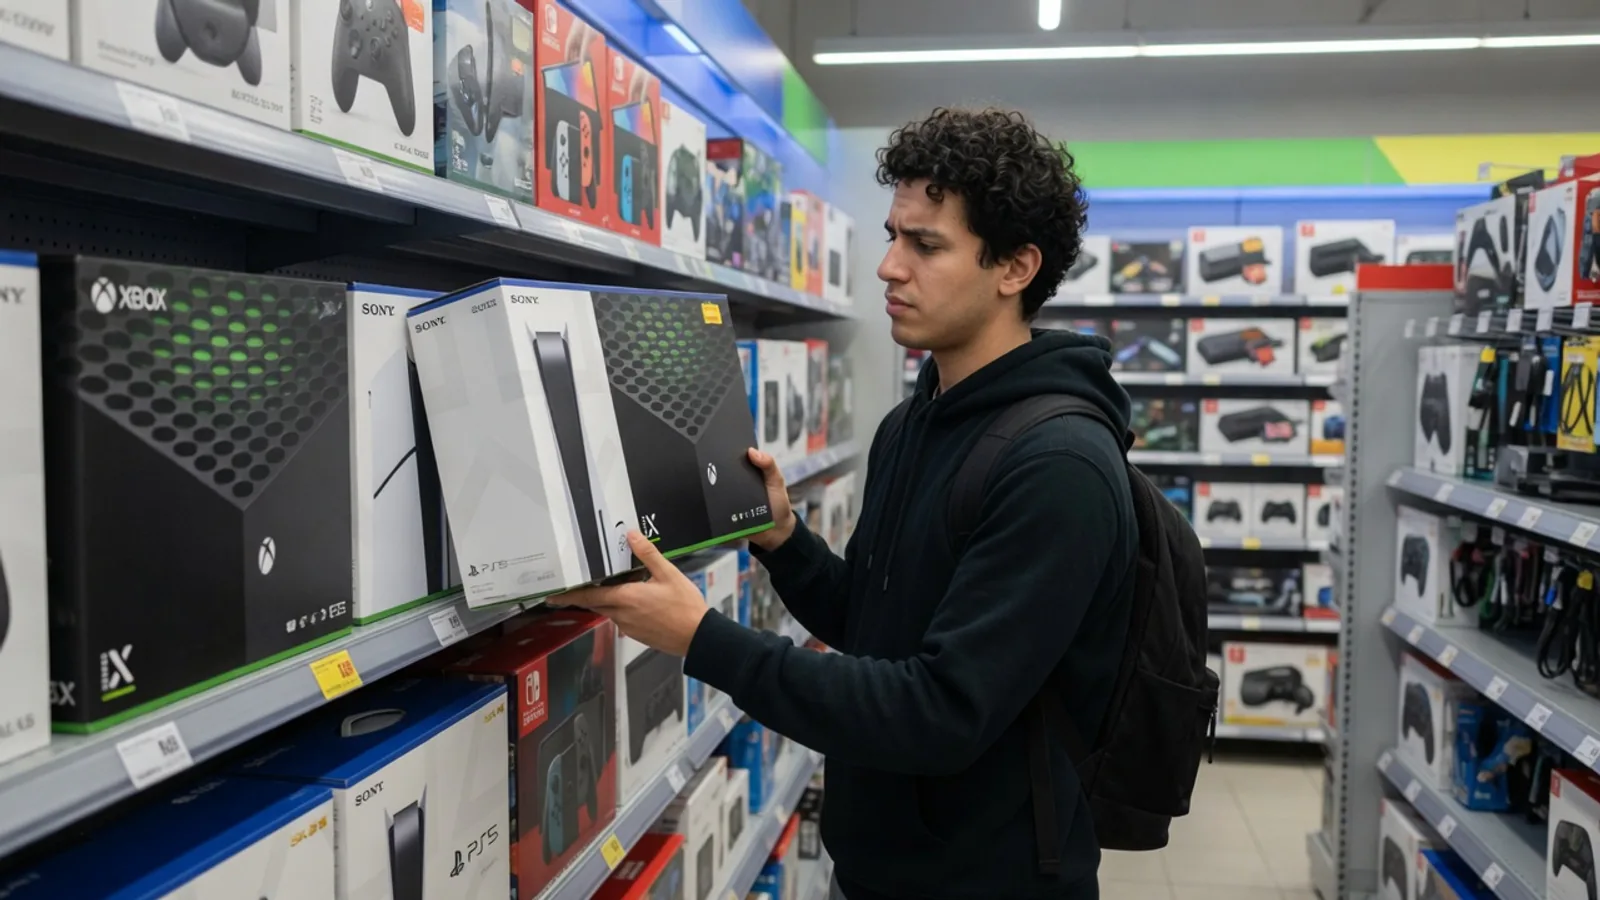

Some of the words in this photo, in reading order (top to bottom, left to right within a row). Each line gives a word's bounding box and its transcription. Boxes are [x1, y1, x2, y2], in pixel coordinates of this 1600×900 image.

[118, 285, 167, 311] XBOX
[511, 294, 539, 305] SONY
[361, 303, 396, 317] SONY
[415, 316, 447, 334] SONY
[467, 823, 499, 863] PS5
